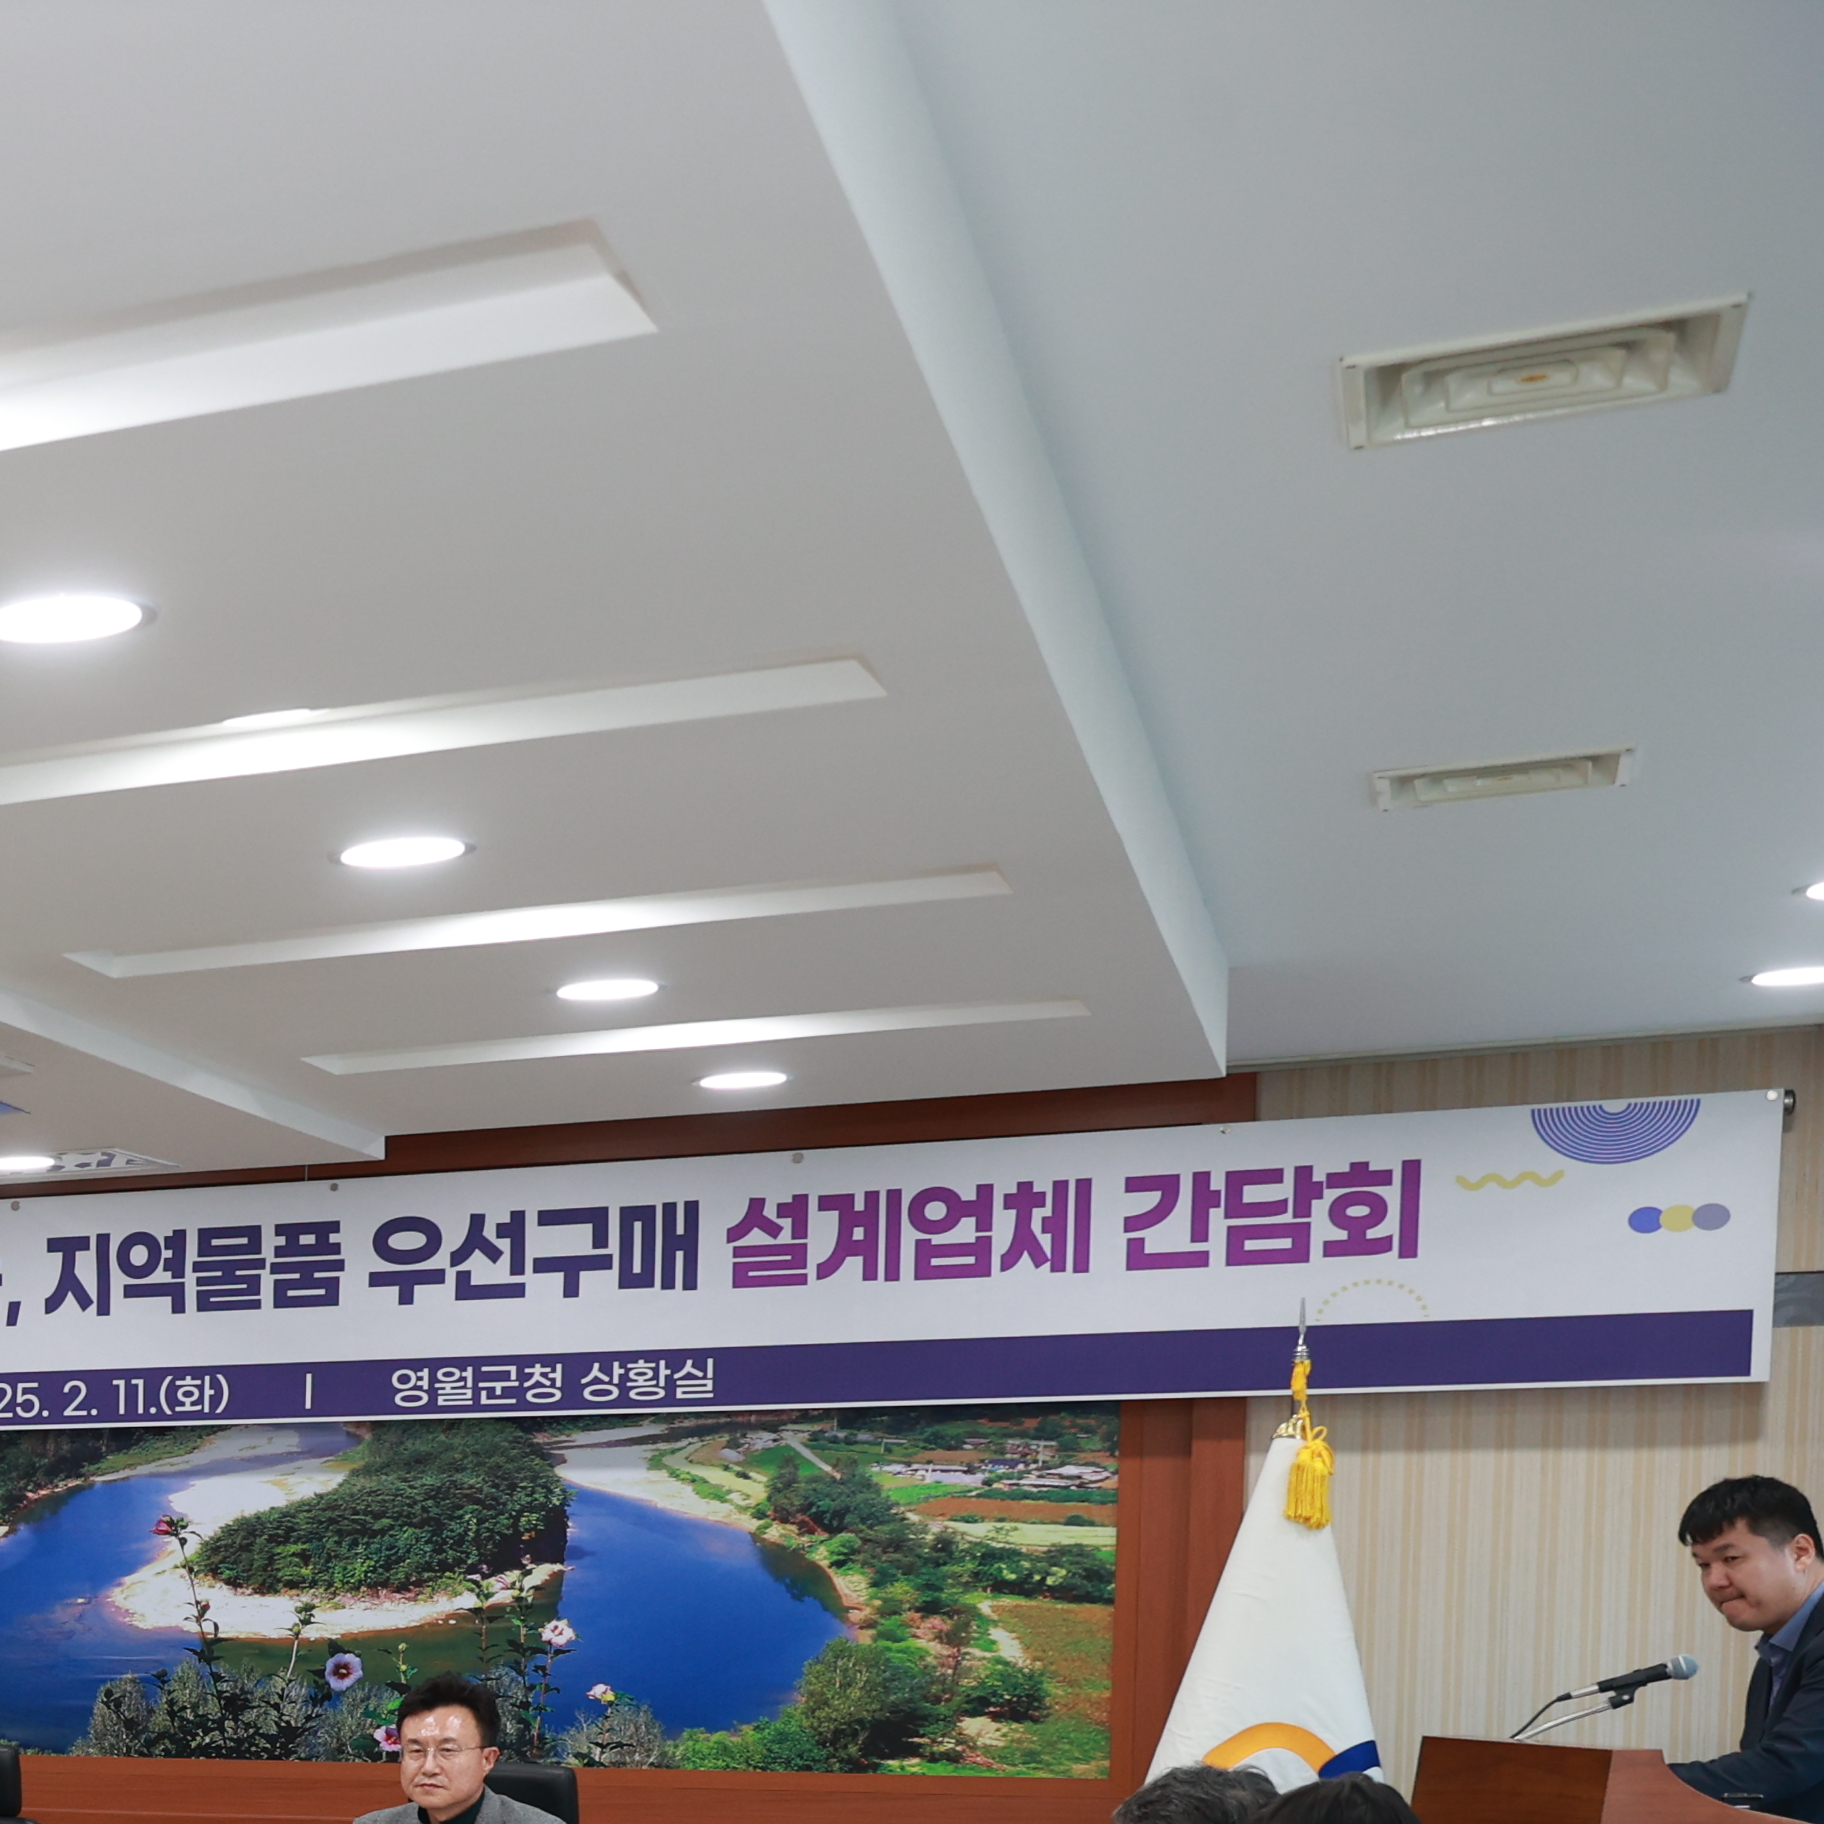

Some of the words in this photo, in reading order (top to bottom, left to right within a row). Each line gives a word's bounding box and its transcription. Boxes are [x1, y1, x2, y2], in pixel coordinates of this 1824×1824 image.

[44, 1219, 346, 1317] 지역물품
[368, 1199, 700, 1306] 우선구매
[726, 1177, 1093, 1289] 설계업체
[1123, 1158, 1422, 1272] 간담회
[63, 1380, 98, 1416] 2.
[112, 1374, 229, 1415] 11.(화)
[391, 1363, 562, 1407] 영월군청
[580, 1358, 714, 1402] 상황실
